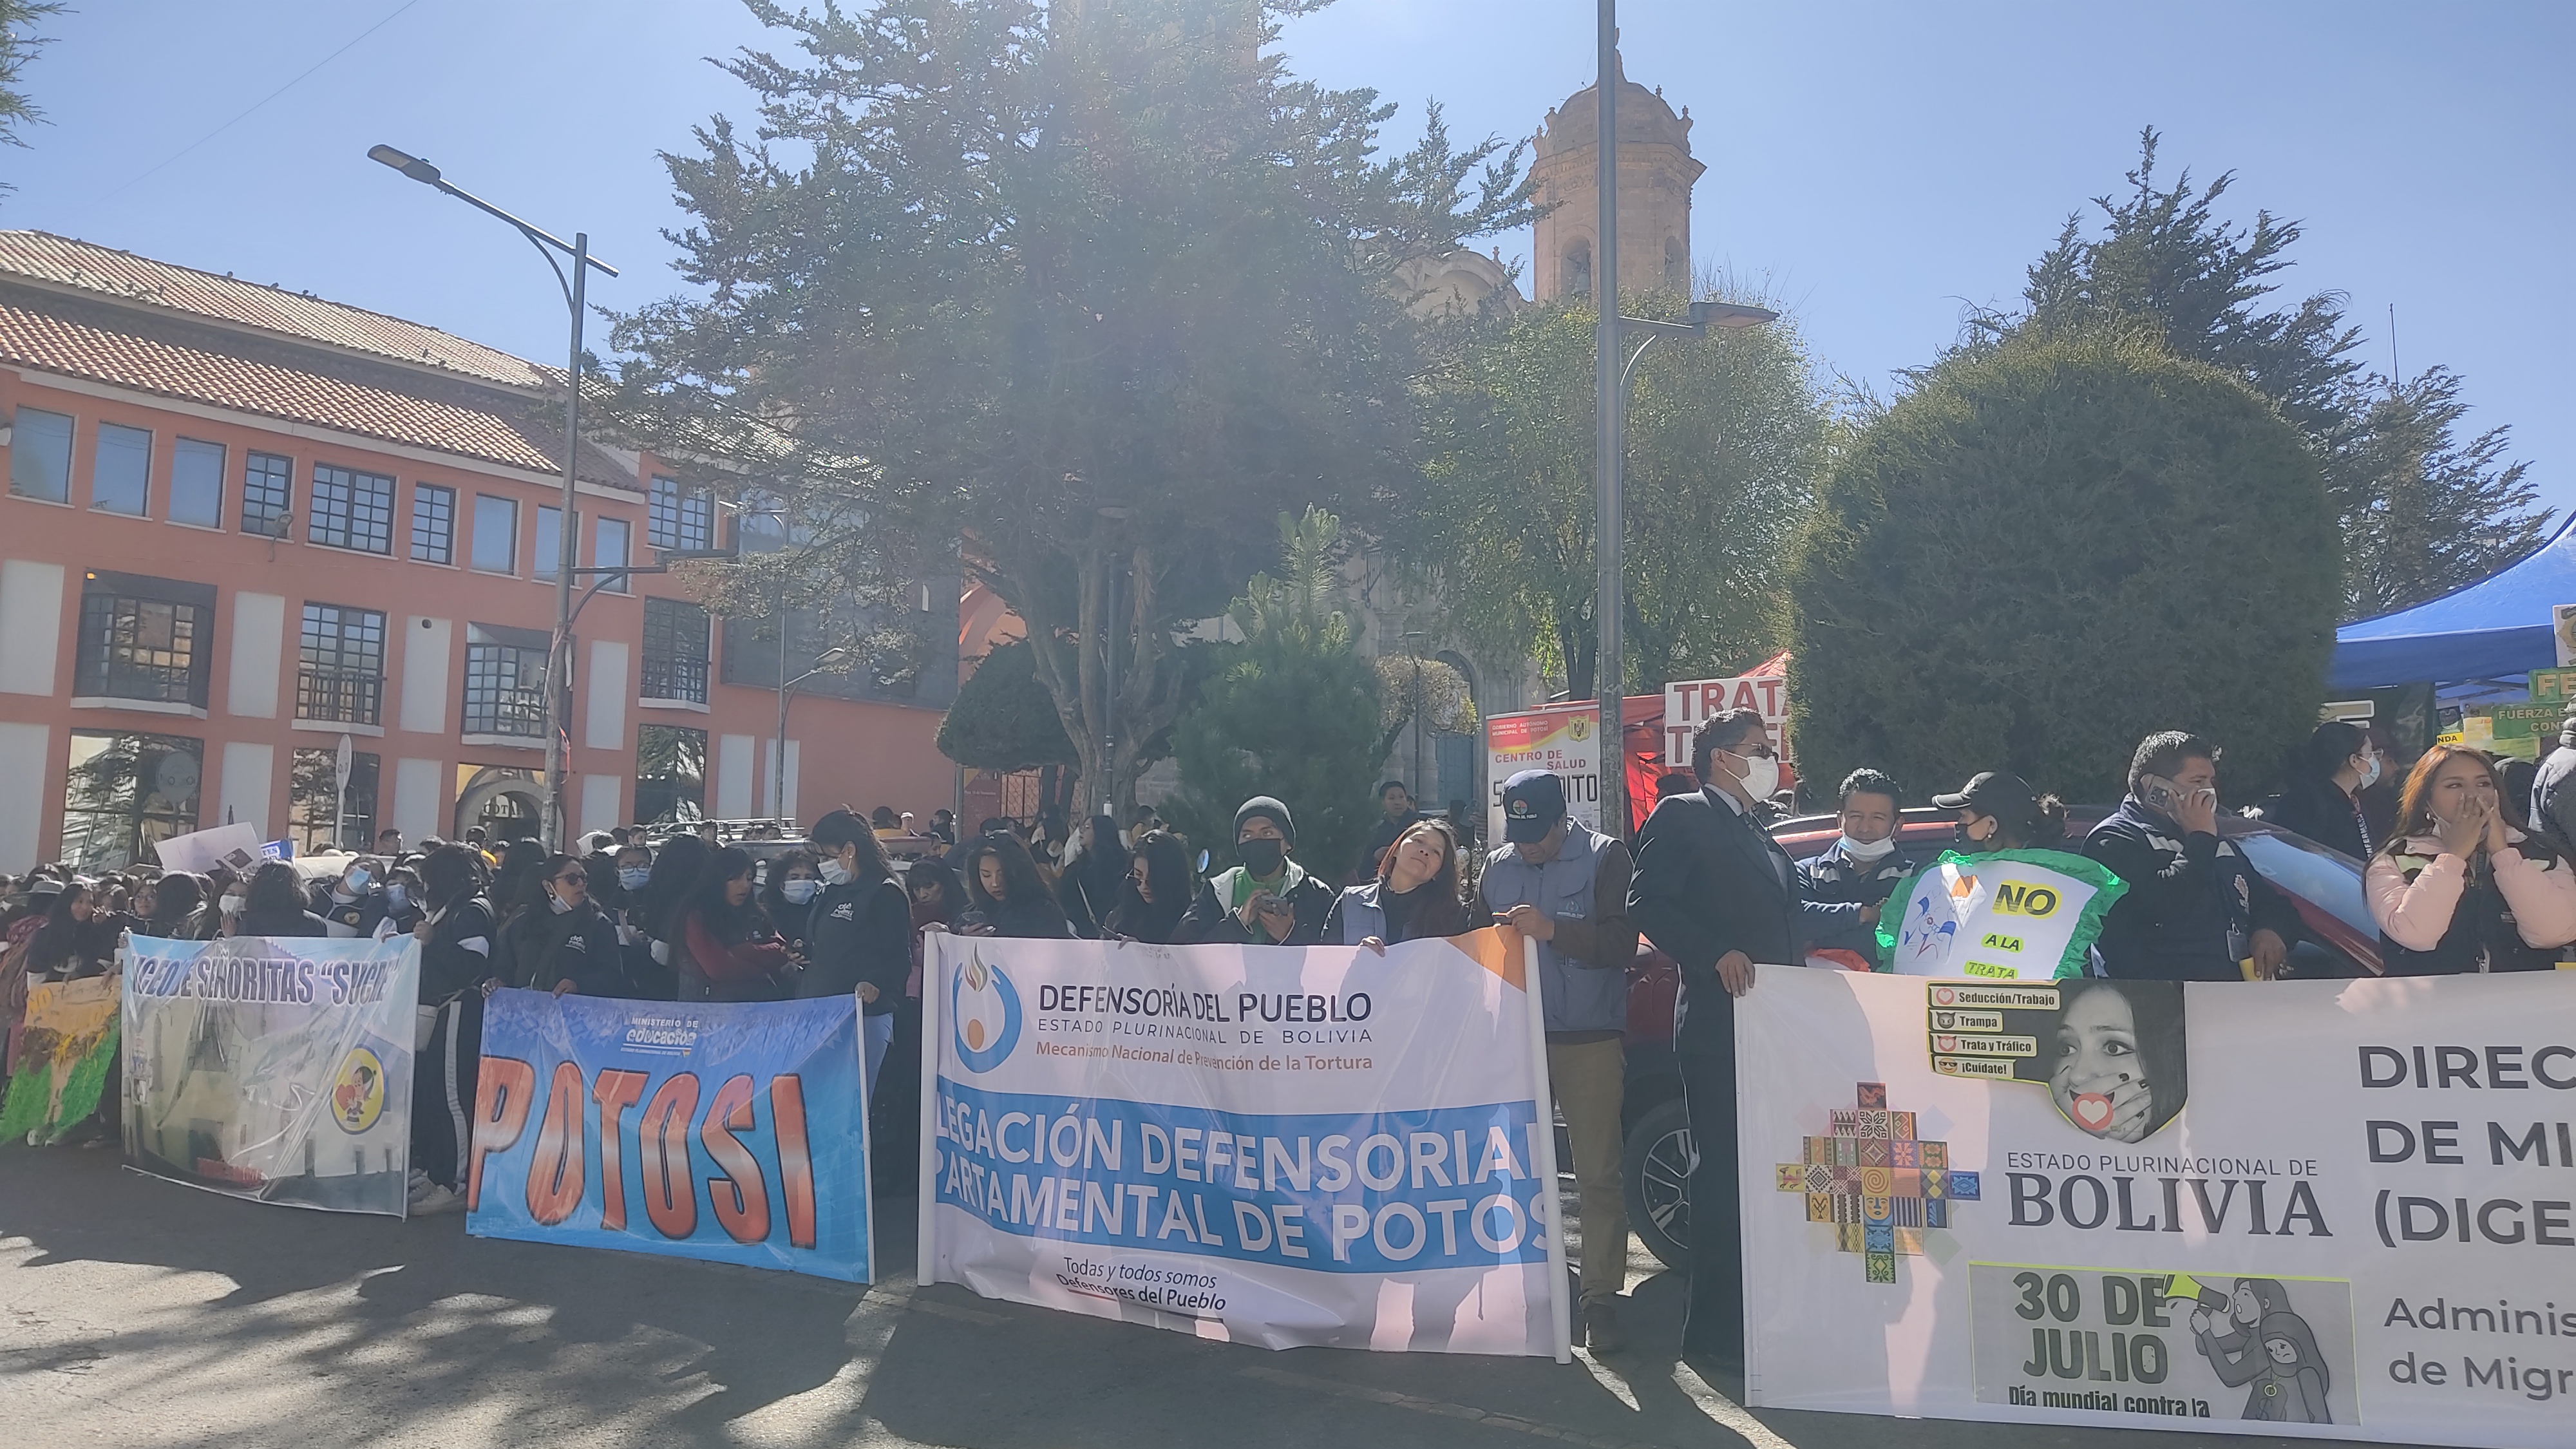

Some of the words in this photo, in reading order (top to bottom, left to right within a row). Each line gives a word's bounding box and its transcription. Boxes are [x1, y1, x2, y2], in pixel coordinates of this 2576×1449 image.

[2498, 709, 2553, 720] FUERZA
[1495, 751, 1542, 763] CENTRO
[1548, 750, 1562, 759] DE
[1547, 759, 1586, 770] SALUD
[1994, 884, 2057, 916] NO
[1985, 935, 1997, 946] A
[2000, 936, 2020, 951] LA
[1968, 962, 2016, 980] TRATA
[1039, 983, 1191, 1019] DEFENSORÍA
[1193, 992, 1230, 1023] DEL
[1239, 992, 1372, 1023] PUEBLO
[1959, 992, 2054, 1006] Seducción/Trabajo
[631, 1018, 681, 1028] MINISTERIO
[1038, 1019, 1103, 1033] ESTADO
[1113, 1021, 1227, 1044] PLURINACIONAL
[1240, 1030, 1264, 1044] DE
[1283, 1029, 1372, 1044] BOLIVIA
[1960, 1016, 1998, 1028] Trampa
[1036, 1041, 1108, 1058] Mecanismo
[1112, 1045, 1174, 1063] Nacional
[1177, 1049, 1193, 1065] de
[1195, 1051, 1254, 1071] Prevención
[1259, 1055, 1281, 1070] de
[1286, 1056, 1301, 1070] la
[1305, 1055, 1372, 1070] Tortura
[1961, 1039, 1986, 1050] Trata
[1989, 1042, 1994, 1051] y
[1996, 1041, 2031, 1052] Tráfico
[1962, 1063, 2007, 1074] ¡Cuídate!
[2358, 1046, 2576, 1090] DIREC
[467, 1055, 817, 1249] POTOSI
[2365, 1120, 2464, 1164] DE
[2486, 1121, 2573, 1167] MI
[2007, 1152, 2091, 1170] ESTADO
[2101, 1156, 2282, 1175] PLURINACIONAL
[2289, 1160, 2318, 1176] DE
[2005, 1172, 2333, 1237] BOLIVIA
[2374, 1189, 2576, 1247] (DIGE
[1233, 1200, 1309, 1258] DE
[1064, 1257, 1104, 1277] Todas
[1106, 1265, 1117, 1282] y
[1119, 1264, 1162, 1283] todos
[1165, 1271, 1217, 1289] somos
[1056, 1273, 1135, 1300] Defensores
[1138, 1285, 1162, 1304] del
[1167, 1287, 1226, 1311] Pueblo
[2012, 1271, 2080, 1322] 30
[2103, 1275, 2170, 1327] DE
[2023, 1328, 2168, 1384] JULIO
[2389, 1351, 2447, 1385] de
[2463, 1356, 2573, 1401] Migr
[2009, 1385, 2036, 1406] Día
[2042, 1391, 2118, 1412] mundial
[2124, 1396, 2187, 1417] contra
[2192, 1398, 2210, 1418] la
